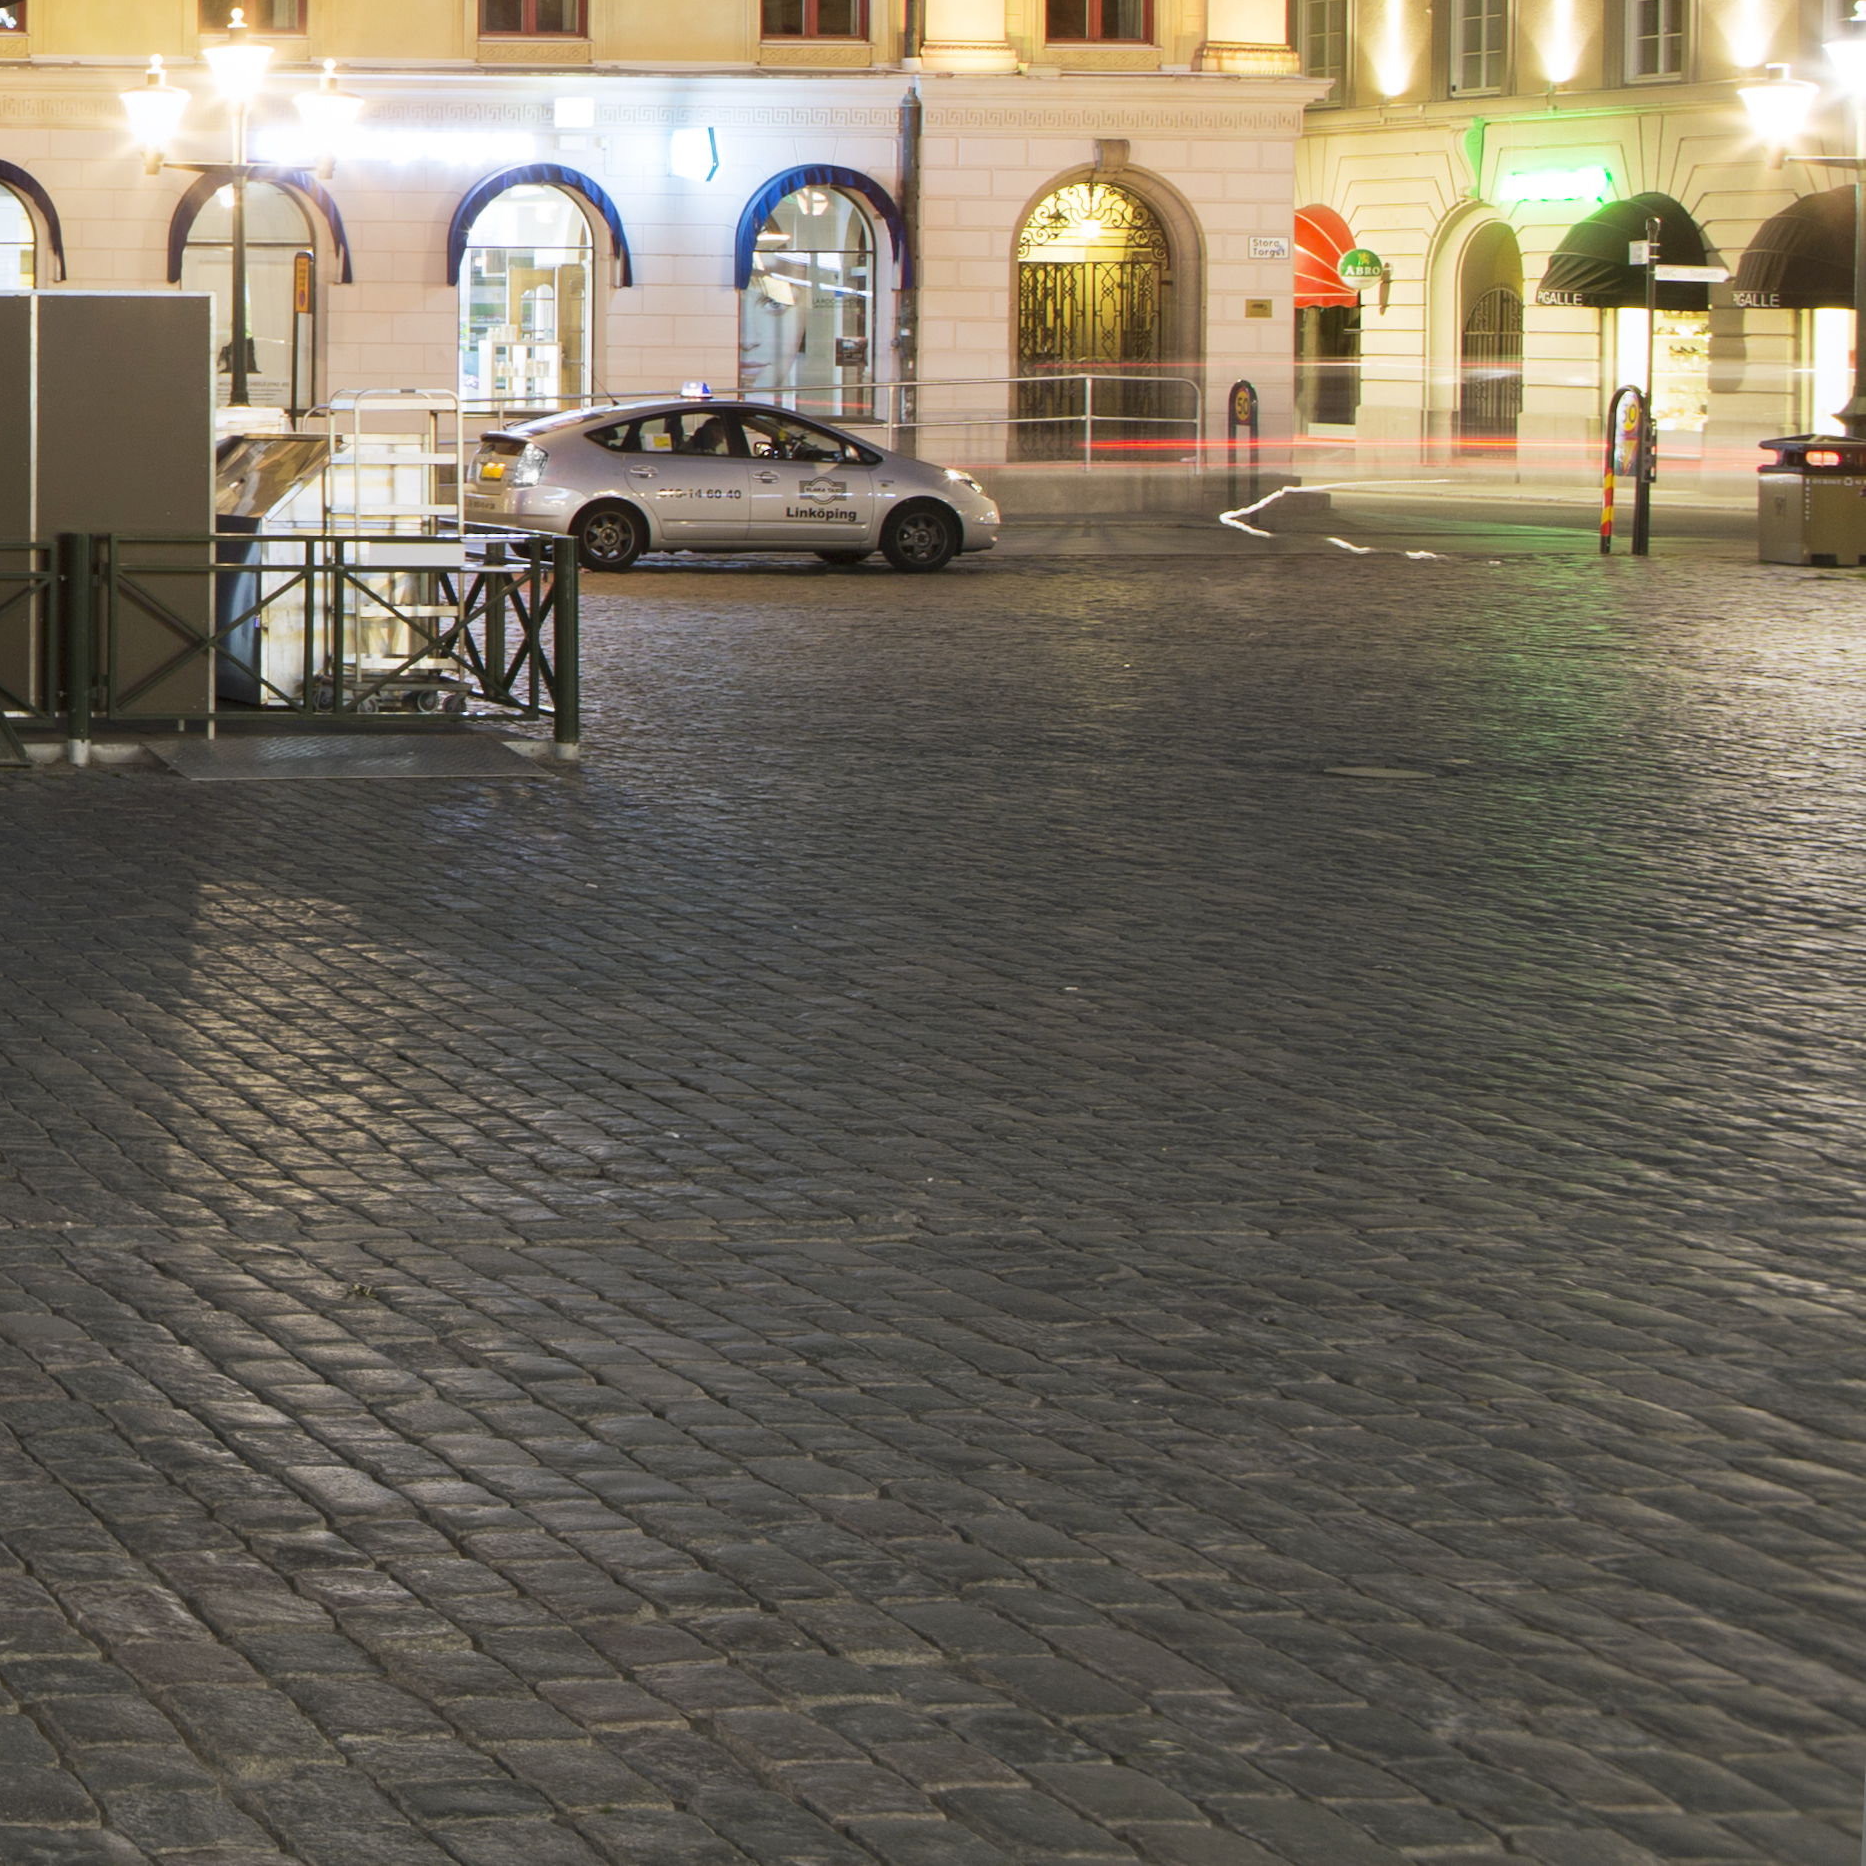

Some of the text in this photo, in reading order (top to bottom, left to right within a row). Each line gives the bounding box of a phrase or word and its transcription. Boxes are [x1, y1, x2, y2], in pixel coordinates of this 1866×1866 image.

[1237, 396, 1249, 415] 50
[706, 489, 722, 499] 60
[726, 489, 742, 500] 40
[786, 506, 857, 522] Linköping
